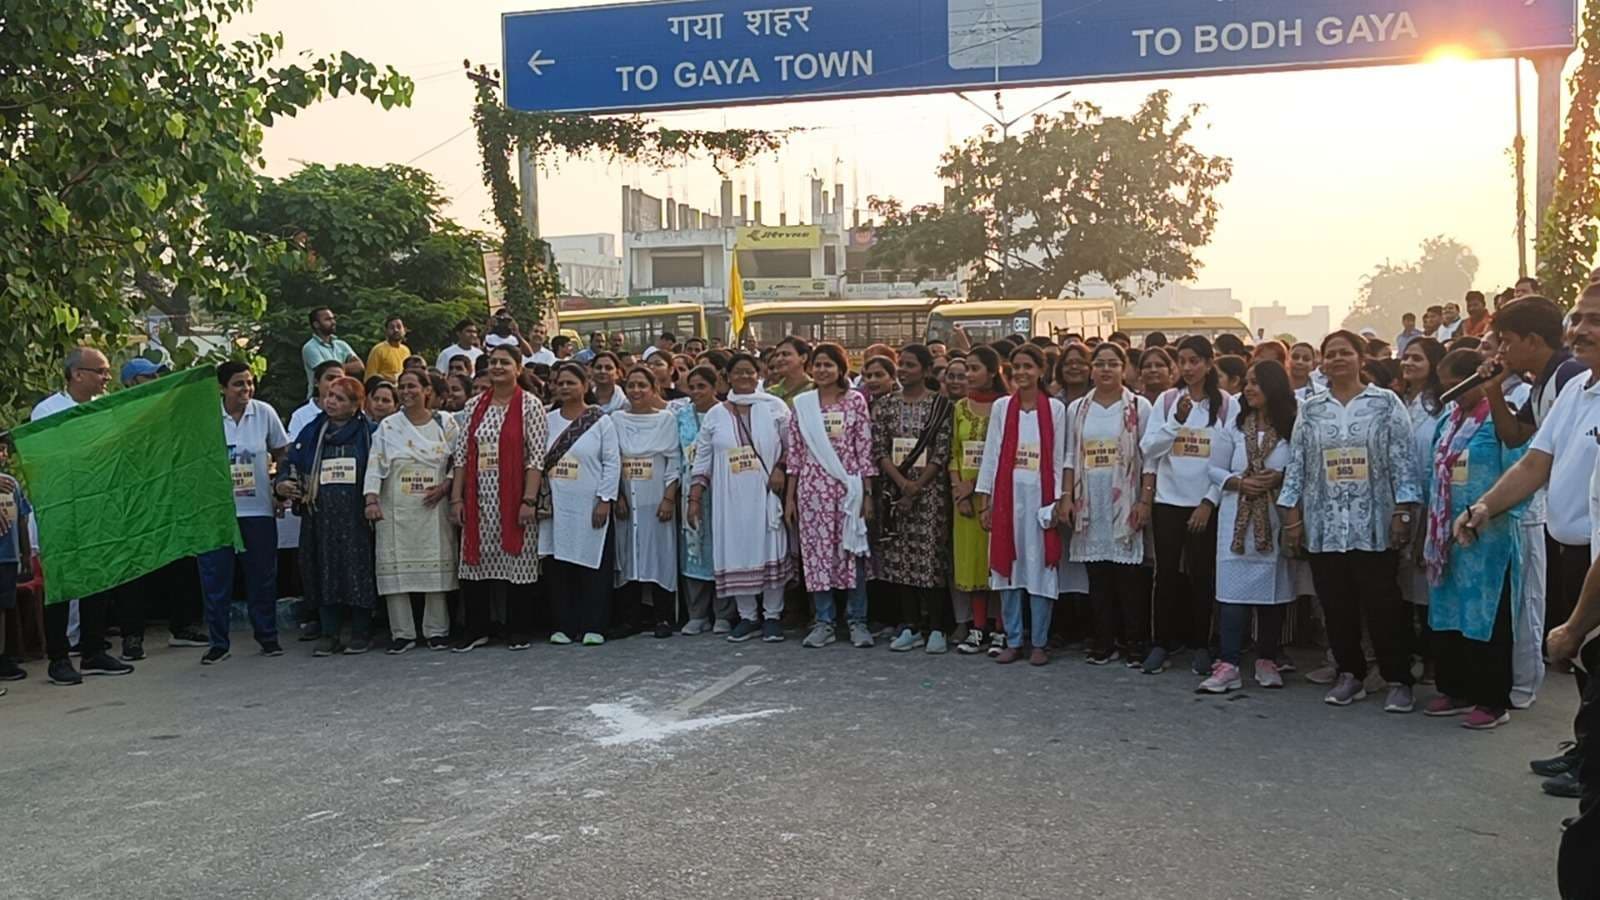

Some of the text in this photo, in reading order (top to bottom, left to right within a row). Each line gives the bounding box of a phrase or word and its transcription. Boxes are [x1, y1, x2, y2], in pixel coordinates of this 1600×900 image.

[667, 6, 813, 42] गया शहर
[1132, 11, 1419, 58] TO BODH GAYA
[616, 49, 874, 92] TO GAYA TOWN
